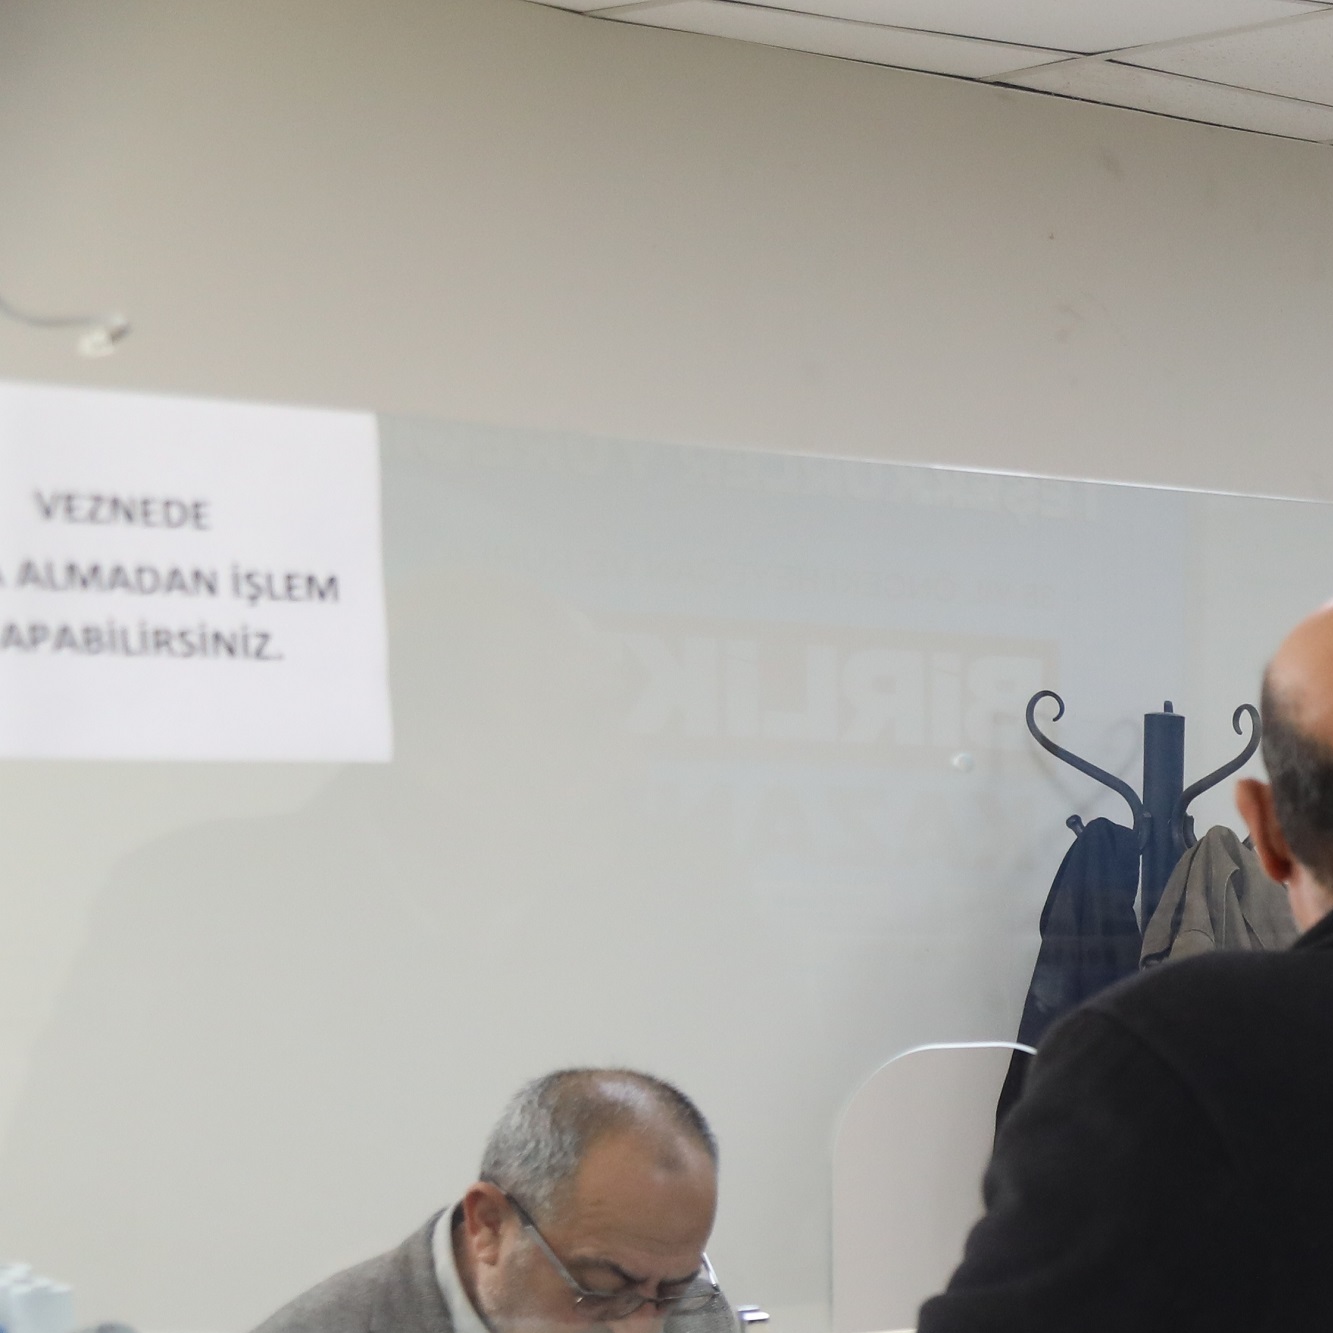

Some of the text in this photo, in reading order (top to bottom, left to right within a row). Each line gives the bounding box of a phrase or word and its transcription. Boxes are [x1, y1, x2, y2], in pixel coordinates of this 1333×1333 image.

[33, 491, 212, 531] VEZNEDE
[16, 560, 218, 597] ALMADAN
[230, 563, 340, 607] İŞLEM
[0, 620, 285, 661] APABİLİRSİNİZ.
